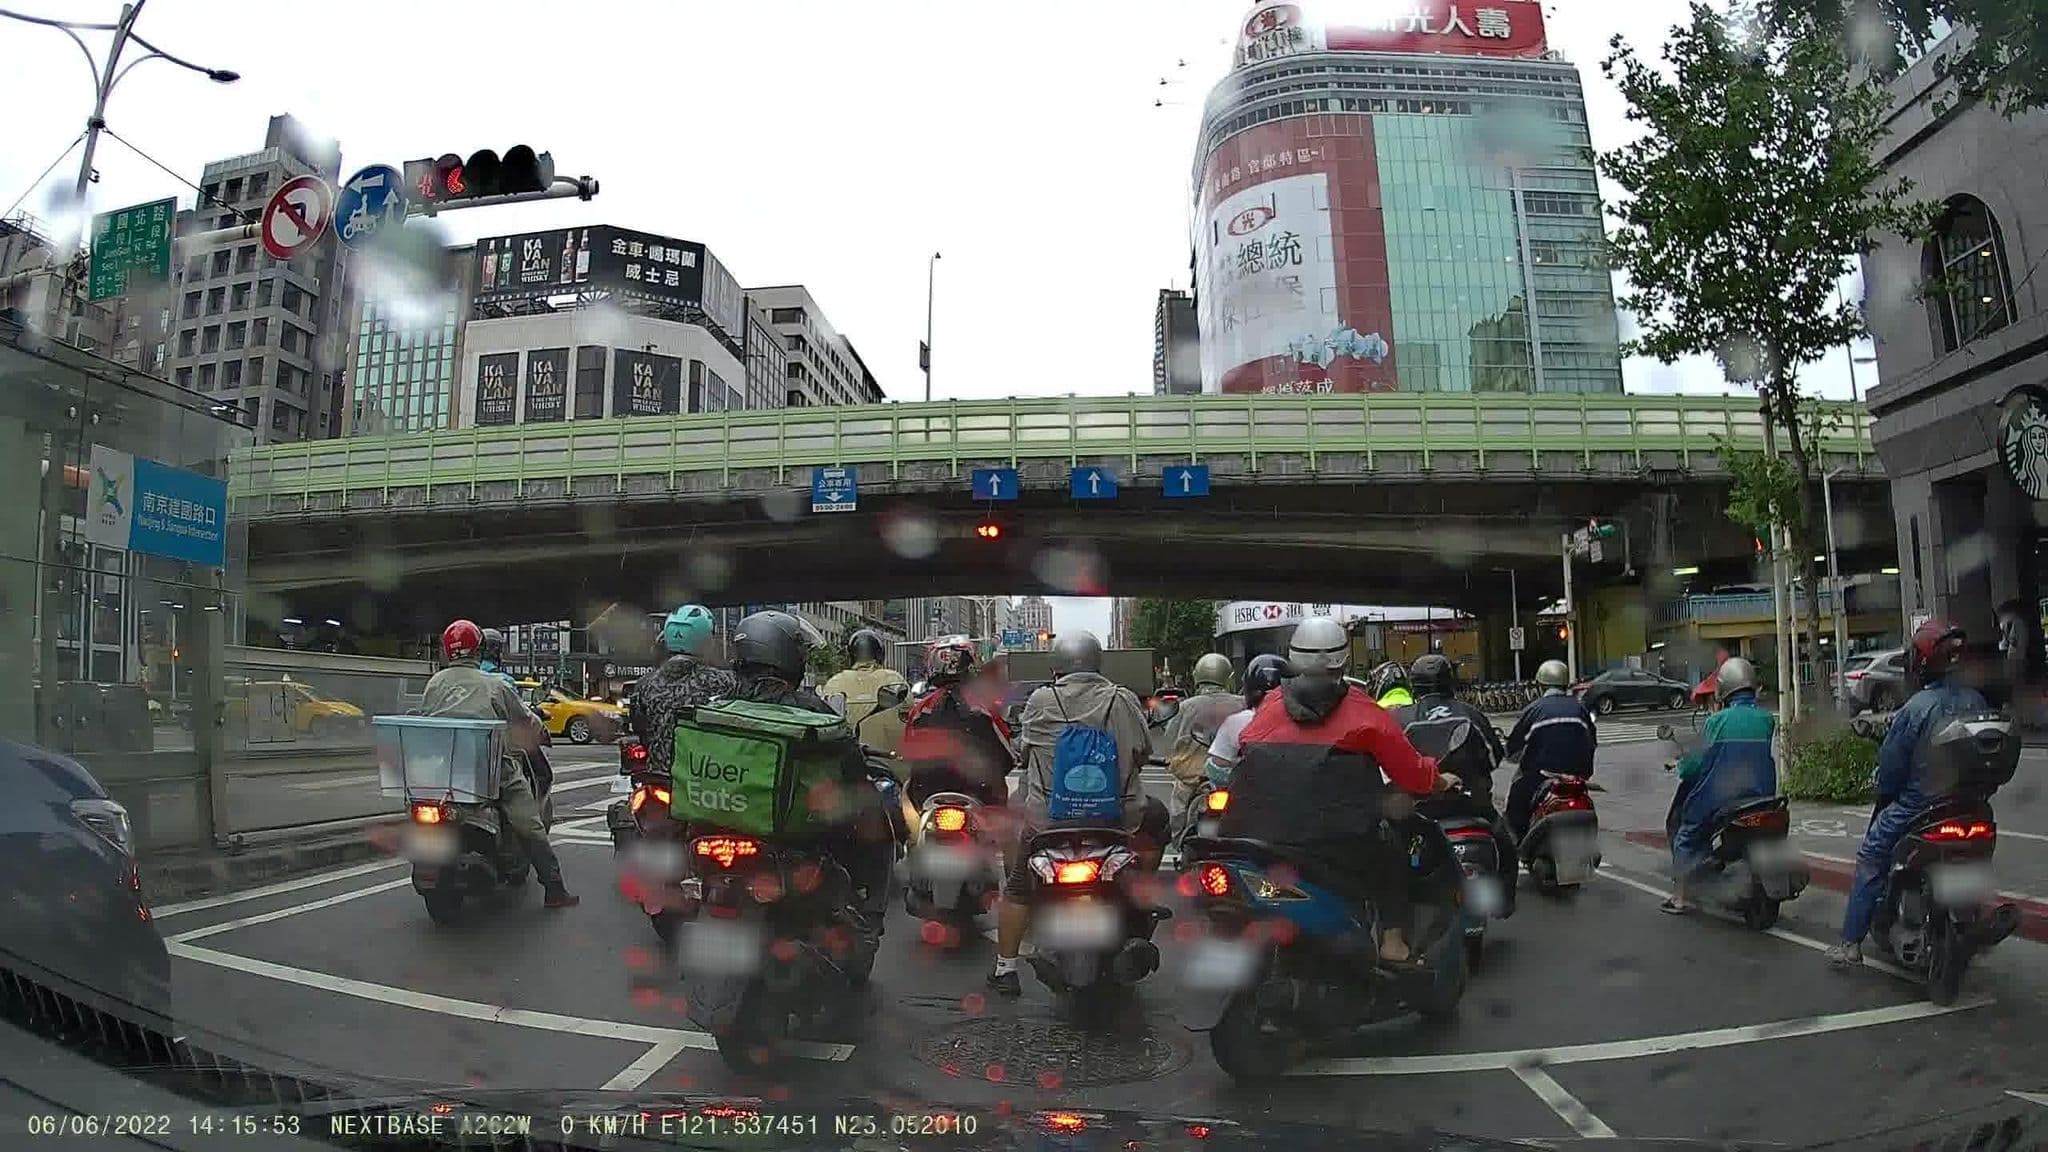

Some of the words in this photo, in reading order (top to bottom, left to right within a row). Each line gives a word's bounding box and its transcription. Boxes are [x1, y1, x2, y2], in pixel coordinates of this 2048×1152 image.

[1380, 4, 1512, 38] 光人壽
[143, 489, 216, 525] 南京建國路口
[1234, 606, 1261, 624] HSBC
[688, 751, 750, 783] Uber
[686, 780, 749, 813] Eats
